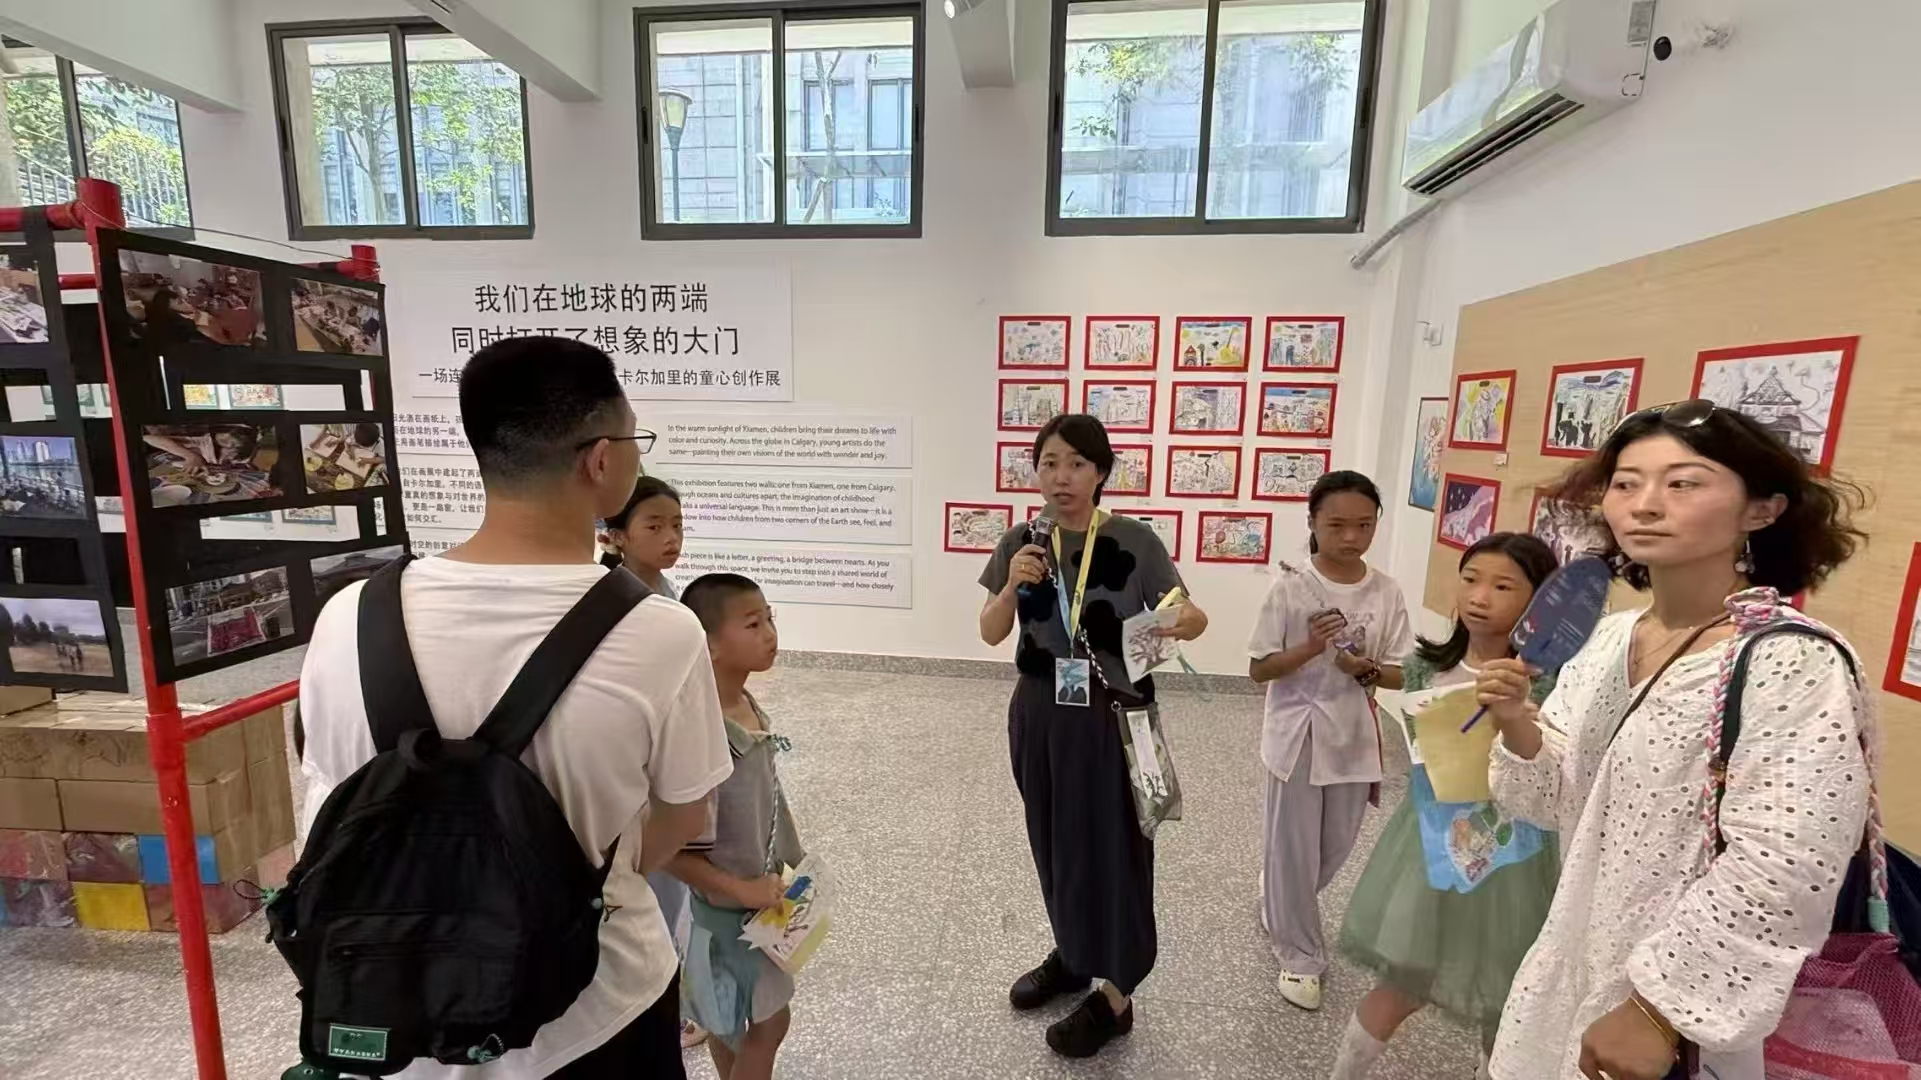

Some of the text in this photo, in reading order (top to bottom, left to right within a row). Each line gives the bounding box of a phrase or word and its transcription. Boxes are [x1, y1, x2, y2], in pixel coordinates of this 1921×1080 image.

[475, 282, 708, 314] 我们在地球的两端
[618, 368, 781, 386] 卡尔加里的童心创作展
[707, 425, 734, 434] sunlight
